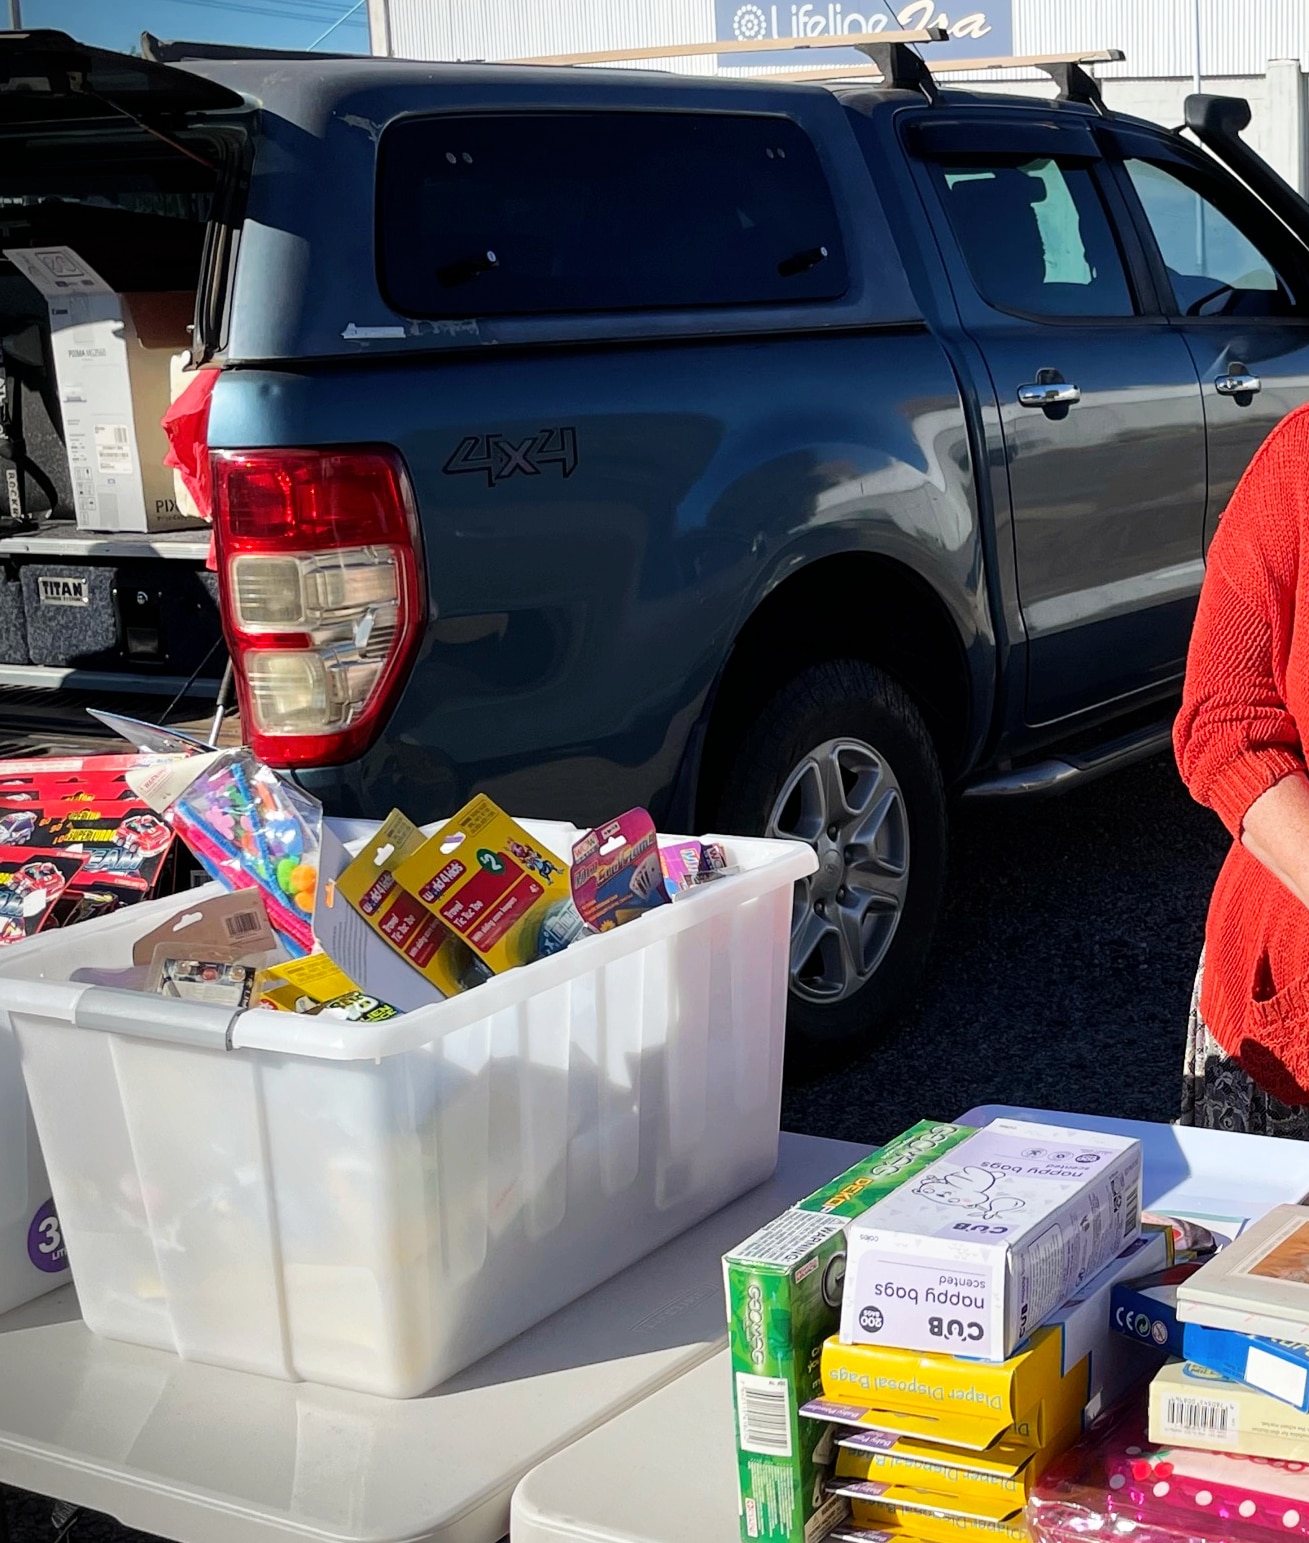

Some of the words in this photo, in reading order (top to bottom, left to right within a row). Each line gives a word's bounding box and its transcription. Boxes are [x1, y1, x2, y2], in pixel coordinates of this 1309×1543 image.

[771, 3, 888, 39] Lifeline
[443, 425, 578, 488] 4x4
[156, 499, 180, 513] PIX
[42, 581, 83, 597] TITAN
[83, 848, 143, 872] EAM
[480, 852, 502, 871] $2
[980, 1161, 1022, 1174] bags
[1027, 1166, 1084, 1179] nappy
[39, 1216, 61, 1253] 3
[860, 1233, 879, 1242] coles
[953, 1222, 1009, 1235] CUB
[939, 1275, 986, 1289] scented
[875, 1282, 919, 1305] bags
[925, 1287, 985, 1309] nappy
[860, 1316, 884, 1328] 200
[928, 1316, 985, 1341] CUB
[830, 1368, 869, 1389] Bags
[874, 1376, 944, 1400] Disposal
[948, 1386, 1002, 1410] Diaper
